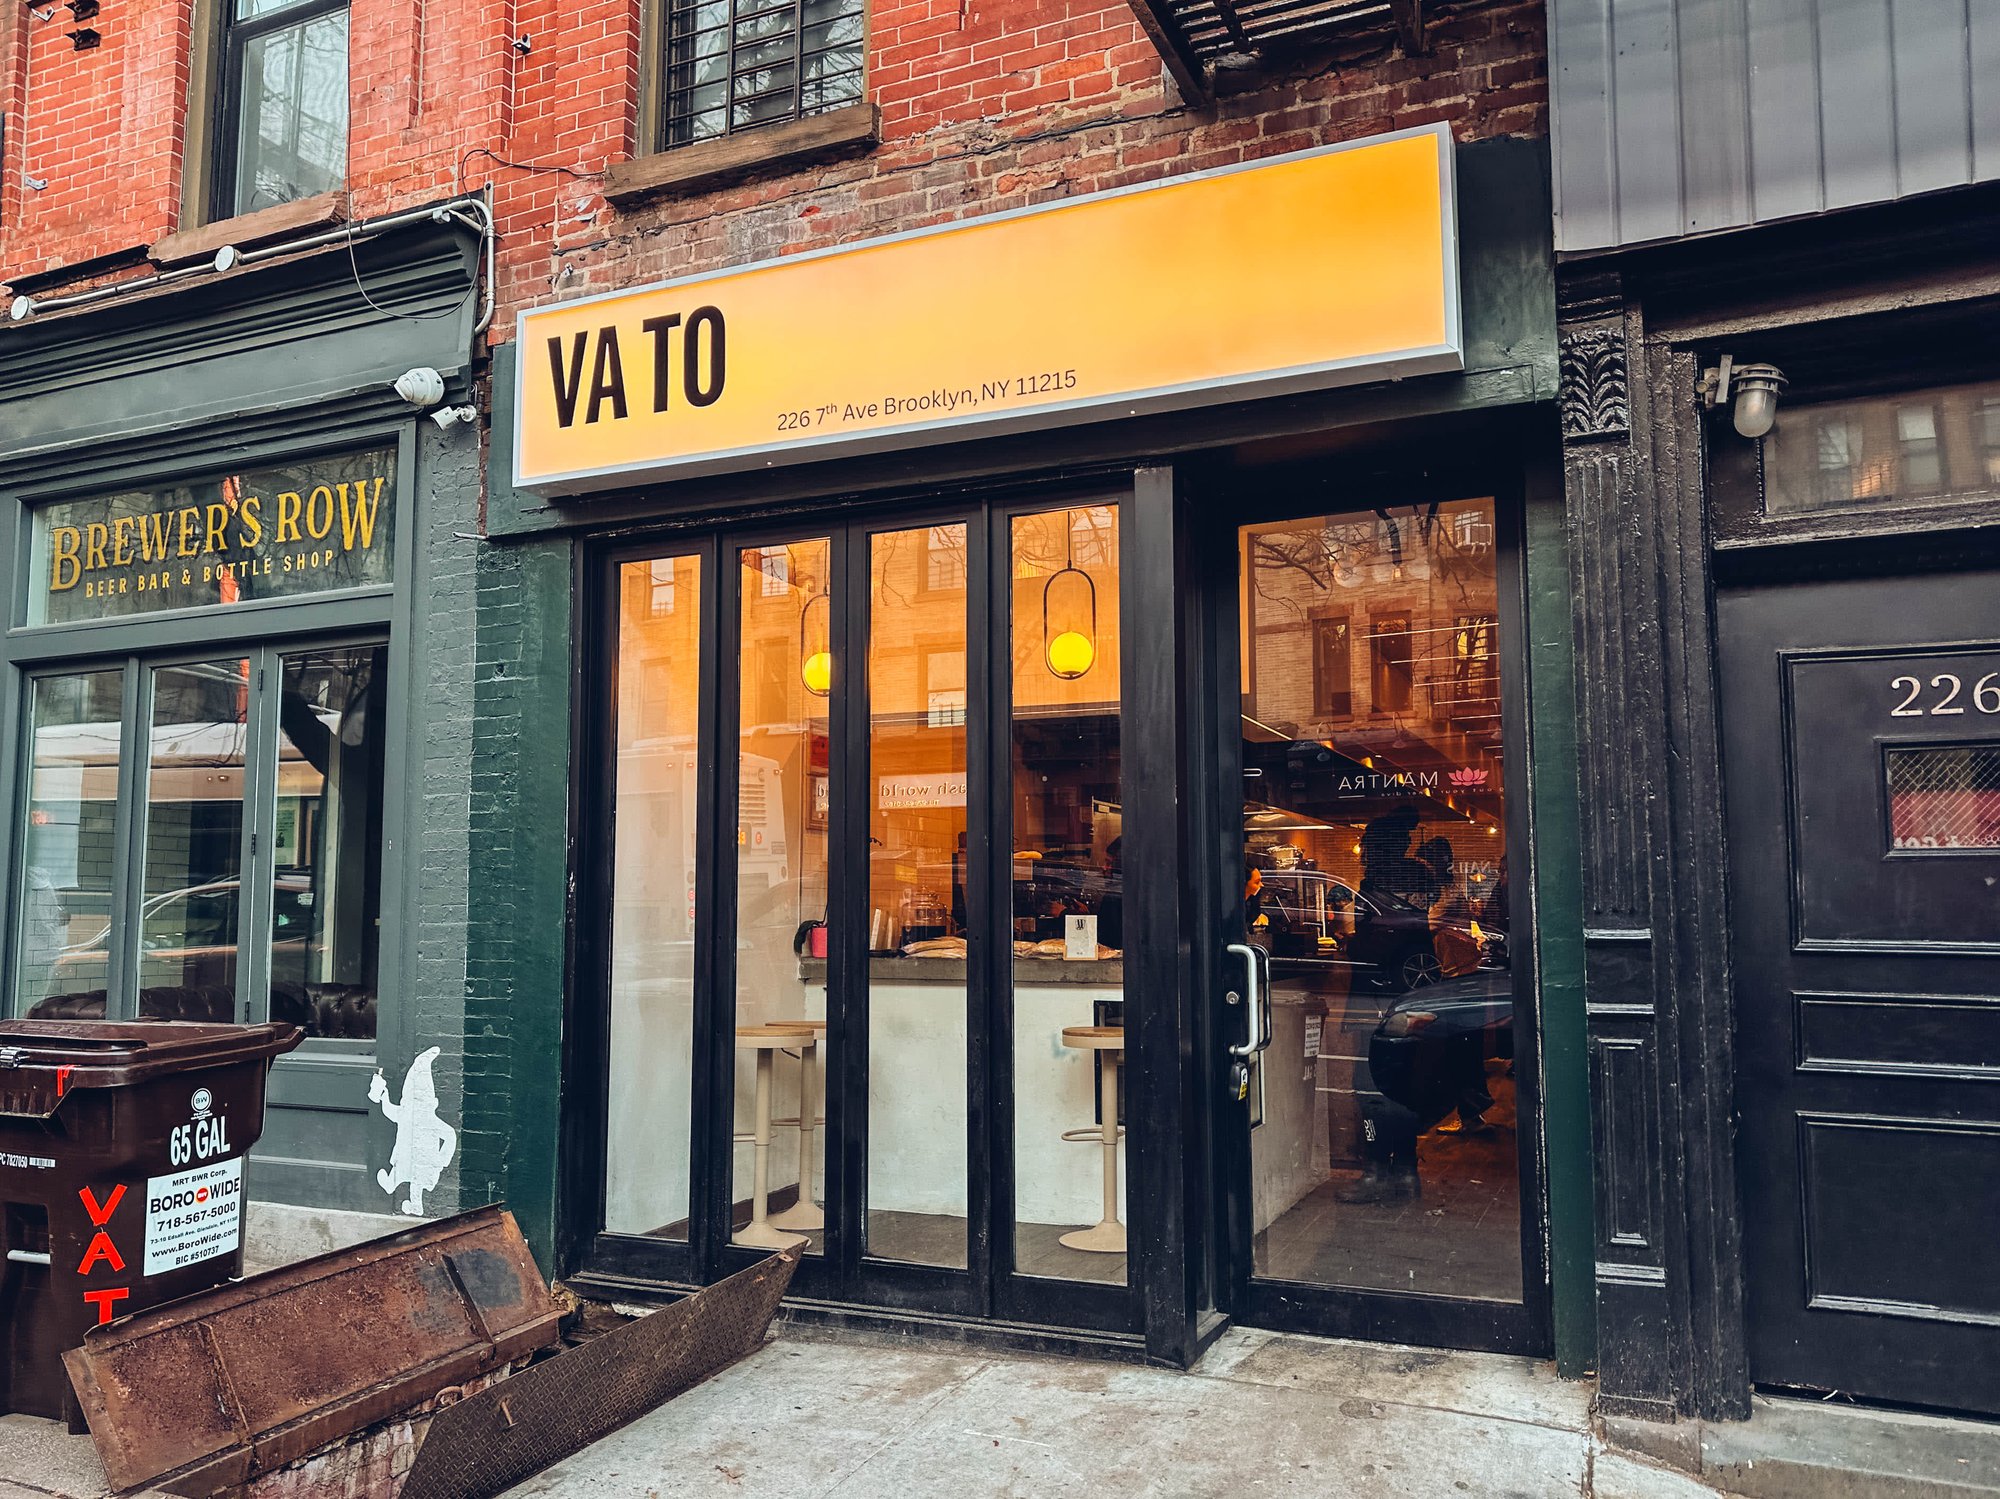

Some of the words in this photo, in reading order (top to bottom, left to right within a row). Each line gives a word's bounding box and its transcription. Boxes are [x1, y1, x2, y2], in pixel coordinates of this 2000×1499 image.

[777, 410, 811, 431] 226
[842, 403, 878, 422] Ave
[884, 388, 978, 416] Brooklyn,
[982, 379, 1011, 401] NY
[1016, 369, 1077, 396] 11215
[50, 495, 262, 591] BREWER'S
[275, 476, 384, 550] ROW
[85, 575, 127, 598] BEER
[138, 570, 170, 592] BAR
[181, 572, 192, 585] &
[203, 556, 272, 582] BOTTLE
[283, 549, 334, 572] SHOP
[1891, 672, 2000, 717] 226
[170, 1124, 191, 1167] 65
[195, 1116, 231, 1159] GAL
[150, 1190, 195, 1214] BORO
[209, 1177, 240, 1200] WIDE
[172, 1177, 190, 1187] MRT
[191, 1173, 209, 1183] BWR
[210, 1169, 228, 1178] Corp.
[157, 1201, 236, 1232] 718-567-5000
[152, 1228, 237, 1258] www.BoroWide.com
[175, 1254, 189, 1265] BIC
[190, 1245, 220, 1258] #510737
